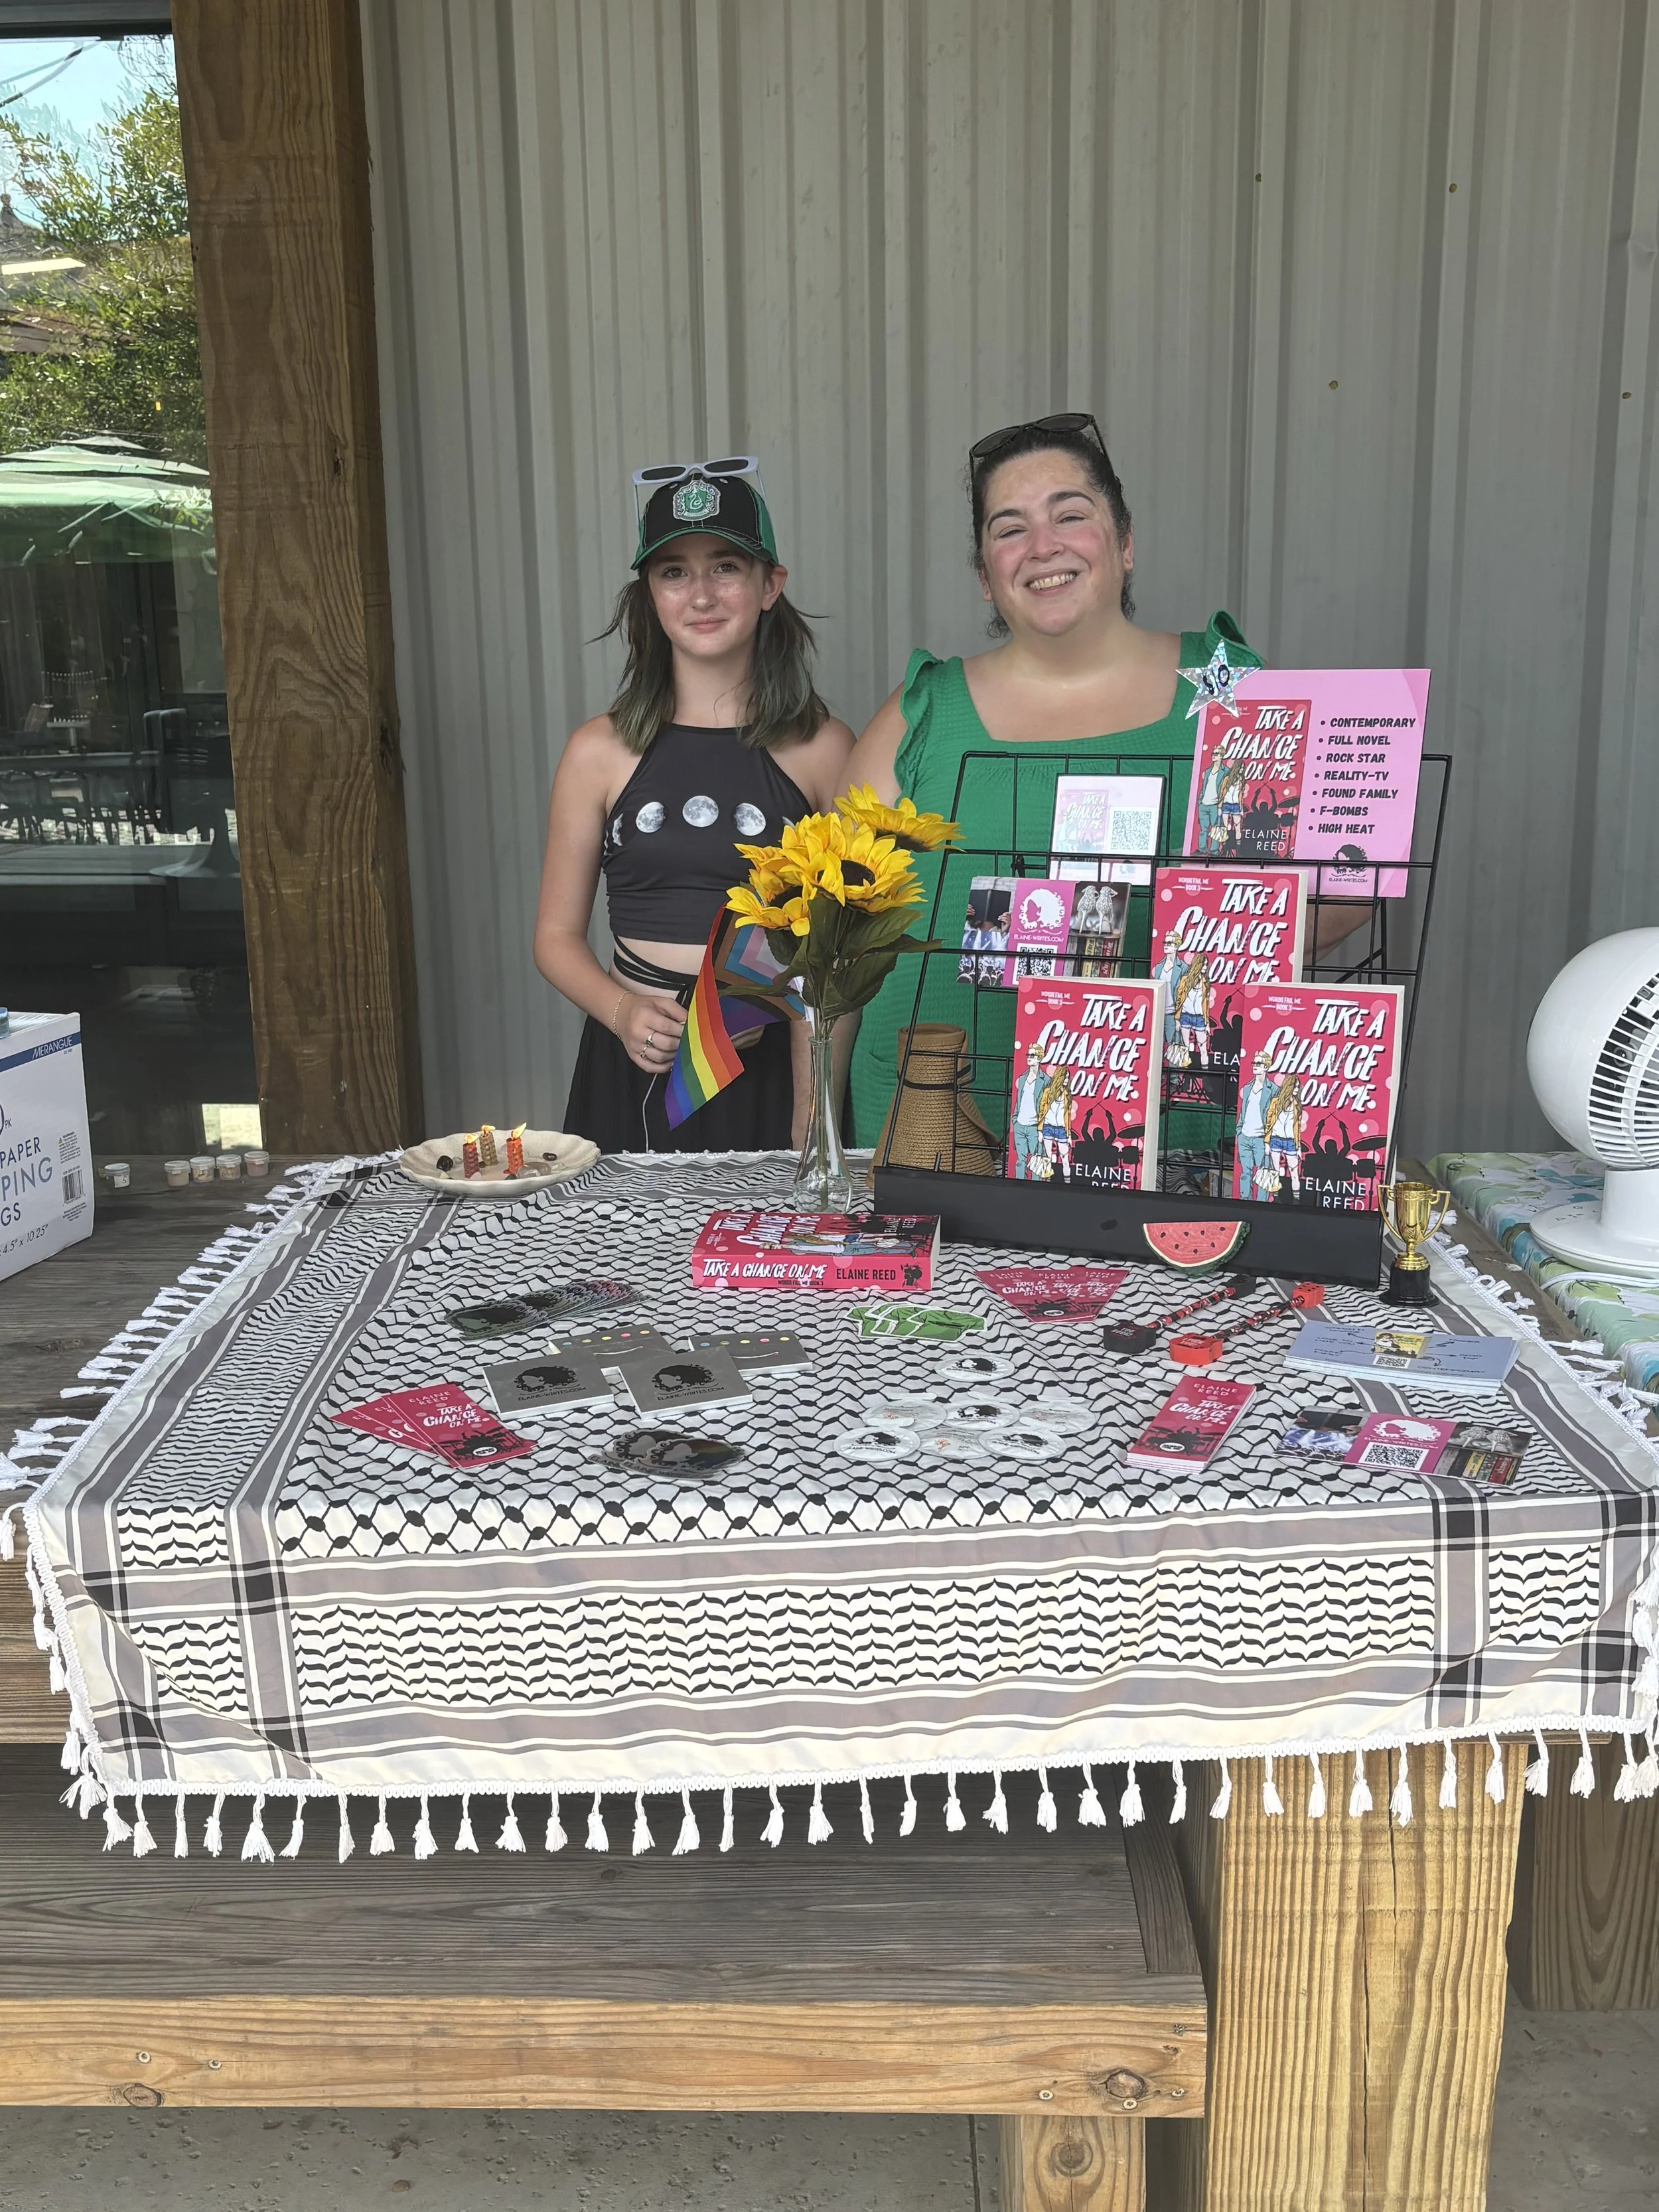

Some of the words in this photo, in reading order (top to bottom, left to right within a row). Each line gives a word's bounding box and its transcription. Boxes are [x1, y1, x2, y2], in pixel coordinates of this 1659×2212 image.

[1254, 705, 1294, 731] TAKE
[1290, 709, 1305, 731] A
[1330, 717, 1416, 728] CONTEMPORARY
[1220, 727, 1303, 761] CHANCE
[1328, 735, 1353, 745] FULL
[1356, 735, 1391, 745] NOVEL
[1326, 753, 1354, 763] ROCK
[1357, 753, 1386, 763] STAR
[1244, 761, 1269, 780] ON
[1269, 762, 1296, 781] ME
[1324, 771, 1389, 780] REALITY-TV
[1082, 792, 1099, 804] TAKE
[1099, 794, 1106, 804] A
[1322, 788, 1356, 798] FOUND
[1359, 788, 1398, 799] FAMILY
[1320, 806, 1368, 816] F-BOMBS
[1245, 829, 1287, 840] ELAINE
[1317, 824, 1342, 834] HIGH
[1345, 824, 1375, 834] HEAT
[1256, 841, 1285, 851] REED
[1219, 878, 1273, 916] TAKE
[1269, 887, 1289, 916] A
[1013, 934, 1064, 942] ELAINE-WRITES.COM
[1173, 906, 1287, 958] CHANCE
[1210, 957, 1246, 985] ON
[1242, 960, 1279, 985] ME
[1080, 994, 1131, 1031] TAKE
[1129, 1004, 1147, 1031] A
[1311, 998, 1369, 1037] TAKE
[1365, 1009, 1386, 1039] A
[33, 1035, 72, 1059] MERANGUE
[1037, 1019, 1146, 1072] CHANCE
[1263, 1026, 1385, 1080] CHANCE
[1070, 1071, 1106, 1098] ON
[1103, 1075, 1138, 1102] ME
[1300, 1079, 1340, 1107] ON
[1336, 1083, 1376, 1112] ME
[5, 1118, 12, 1129] PK
[0, 1136, 41, 1169] PAPER
[1075, 1163, 1131, 1182] ELAINE
[1305, 1177, 1366, 1196] ELAINE
[713, 1217, 751, 1231] TAKE
[703, 1258, 731, 1277] TAKE
[731, 1262, 739, 1277] A
[742, 1262, 788, 1278] CHANCE
[788, 1264, 808, 1279] ON
[808, 1264, 828, 1280] ME
[836, 1268, 869, 1280] ELAINE
[872, 1270, 896, 1280] REED
[1194, 1383, 1238, 1393] ELAINE
[409, 1391, 451, 1403] ELAINE
[419, 1396, 448, 1405] REED
[437, 1405, 463, 1416] TAKE
[1169, 1402, 1232, 1417] CHANCE
[423, 1409, 476, 1427] CHANCE
[449, 1420, 465, 1428] ON
[467, 1416, 481, 1424] ME
